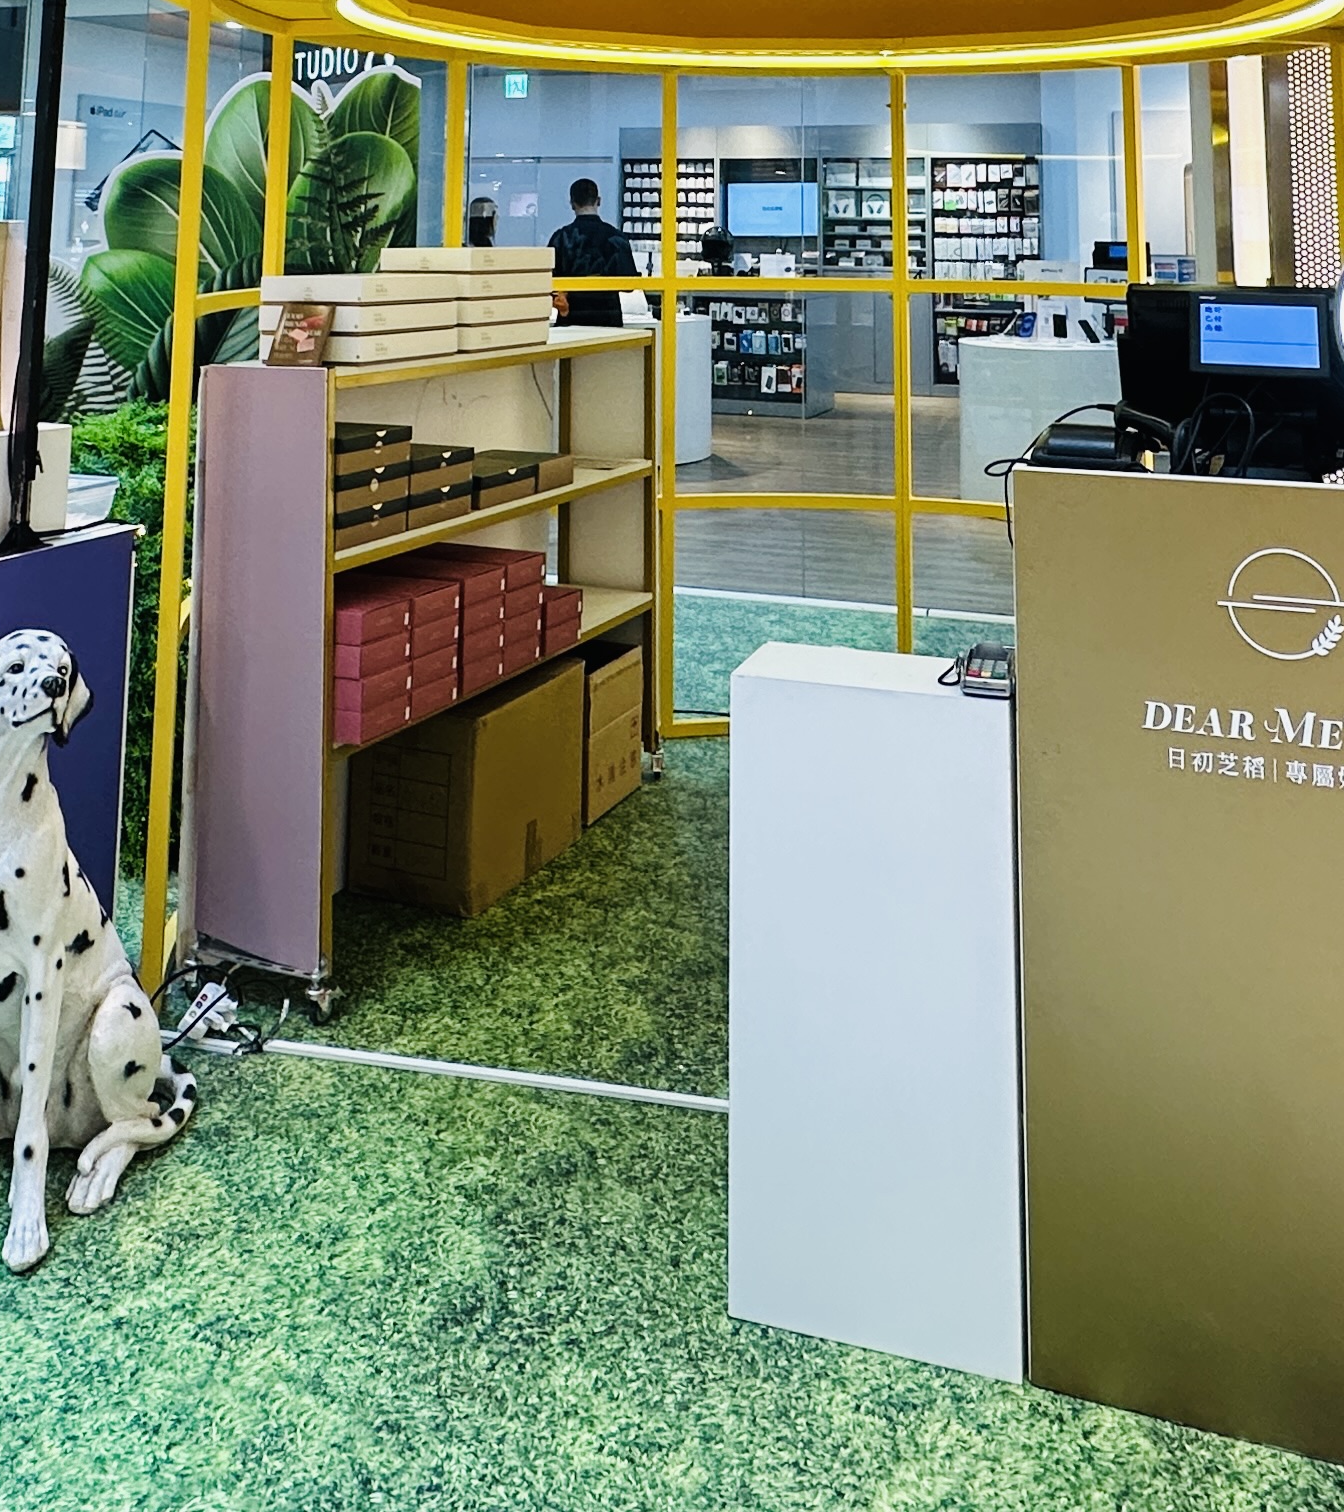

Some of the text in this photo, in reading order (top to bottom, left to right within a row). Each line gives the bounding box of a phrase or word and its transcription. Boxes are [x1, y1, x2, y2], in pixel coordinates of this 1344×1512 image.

[294, 47, 359, 81] TUDIO
[1141, 700, 1257, 741] DEAR
[1167, 746, 1266, 781] 日初芝稻
